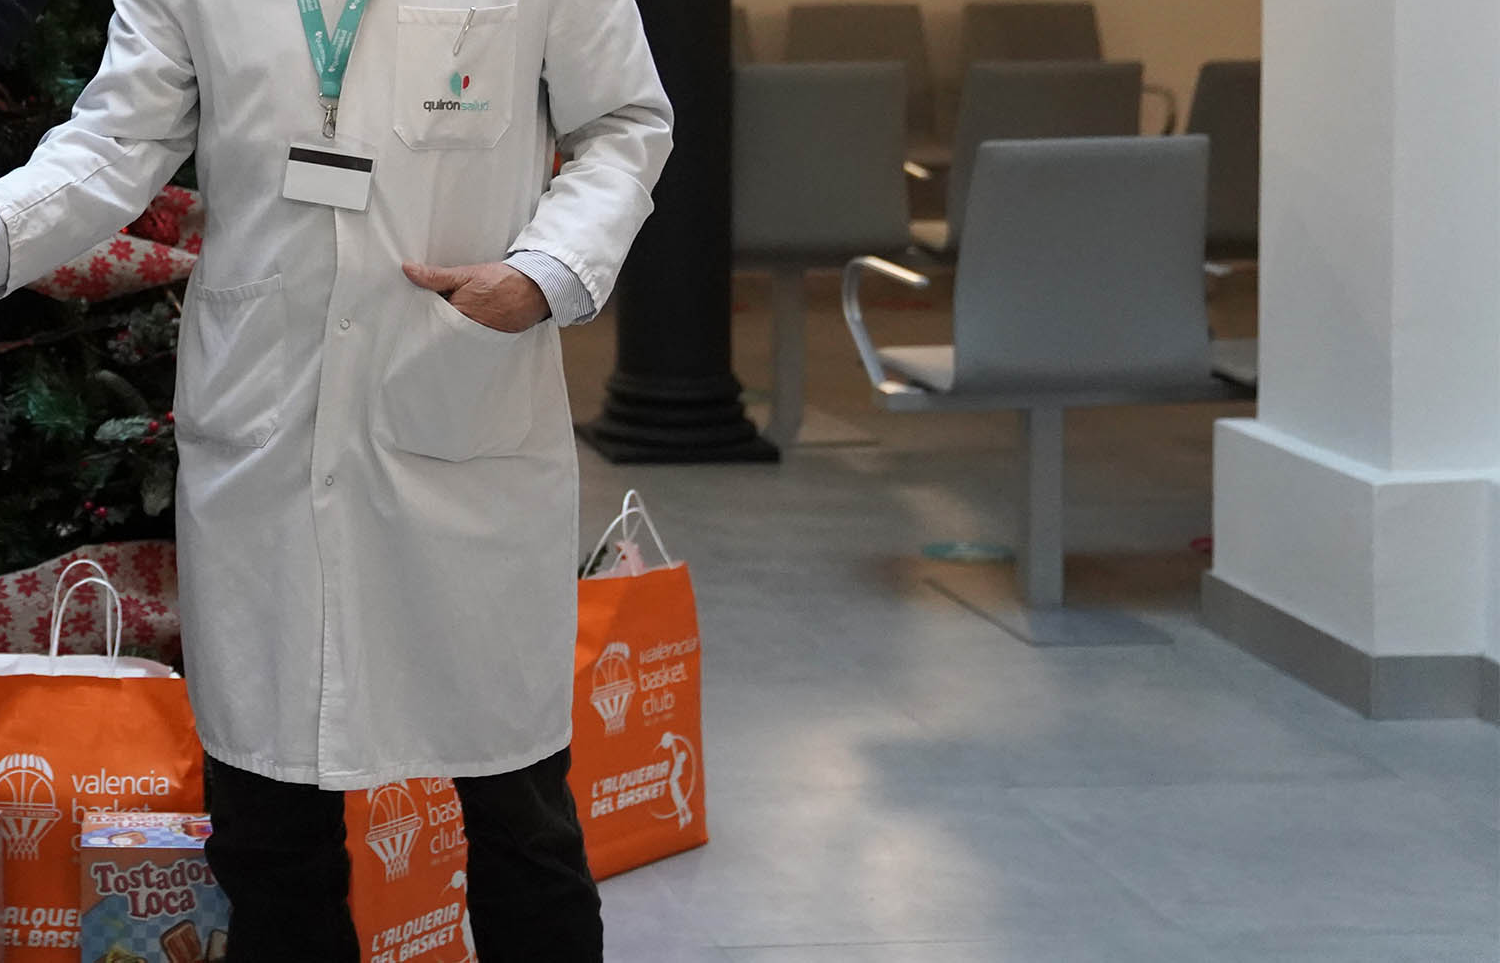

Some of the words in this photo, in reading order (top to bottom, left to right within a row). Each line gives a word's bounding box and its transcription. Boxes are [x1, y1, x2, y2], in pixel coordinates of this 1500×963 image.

[638, 661, 688, 693] basket
[642, 690, 676, 717] club
[71, 768, 170, 796] valencia
[591, 760, 669, 799] L'ALQUERIA
[591, 796, 614, 819] DEL
[616, 779, 669, 811] BASKET
[92, 861, 216, 894] Tostador
[127, 888, 197, 919] Loca
[371, 901, 460, 952] L'ALQUERIA
[399, 923, 459, 962] BASKET
